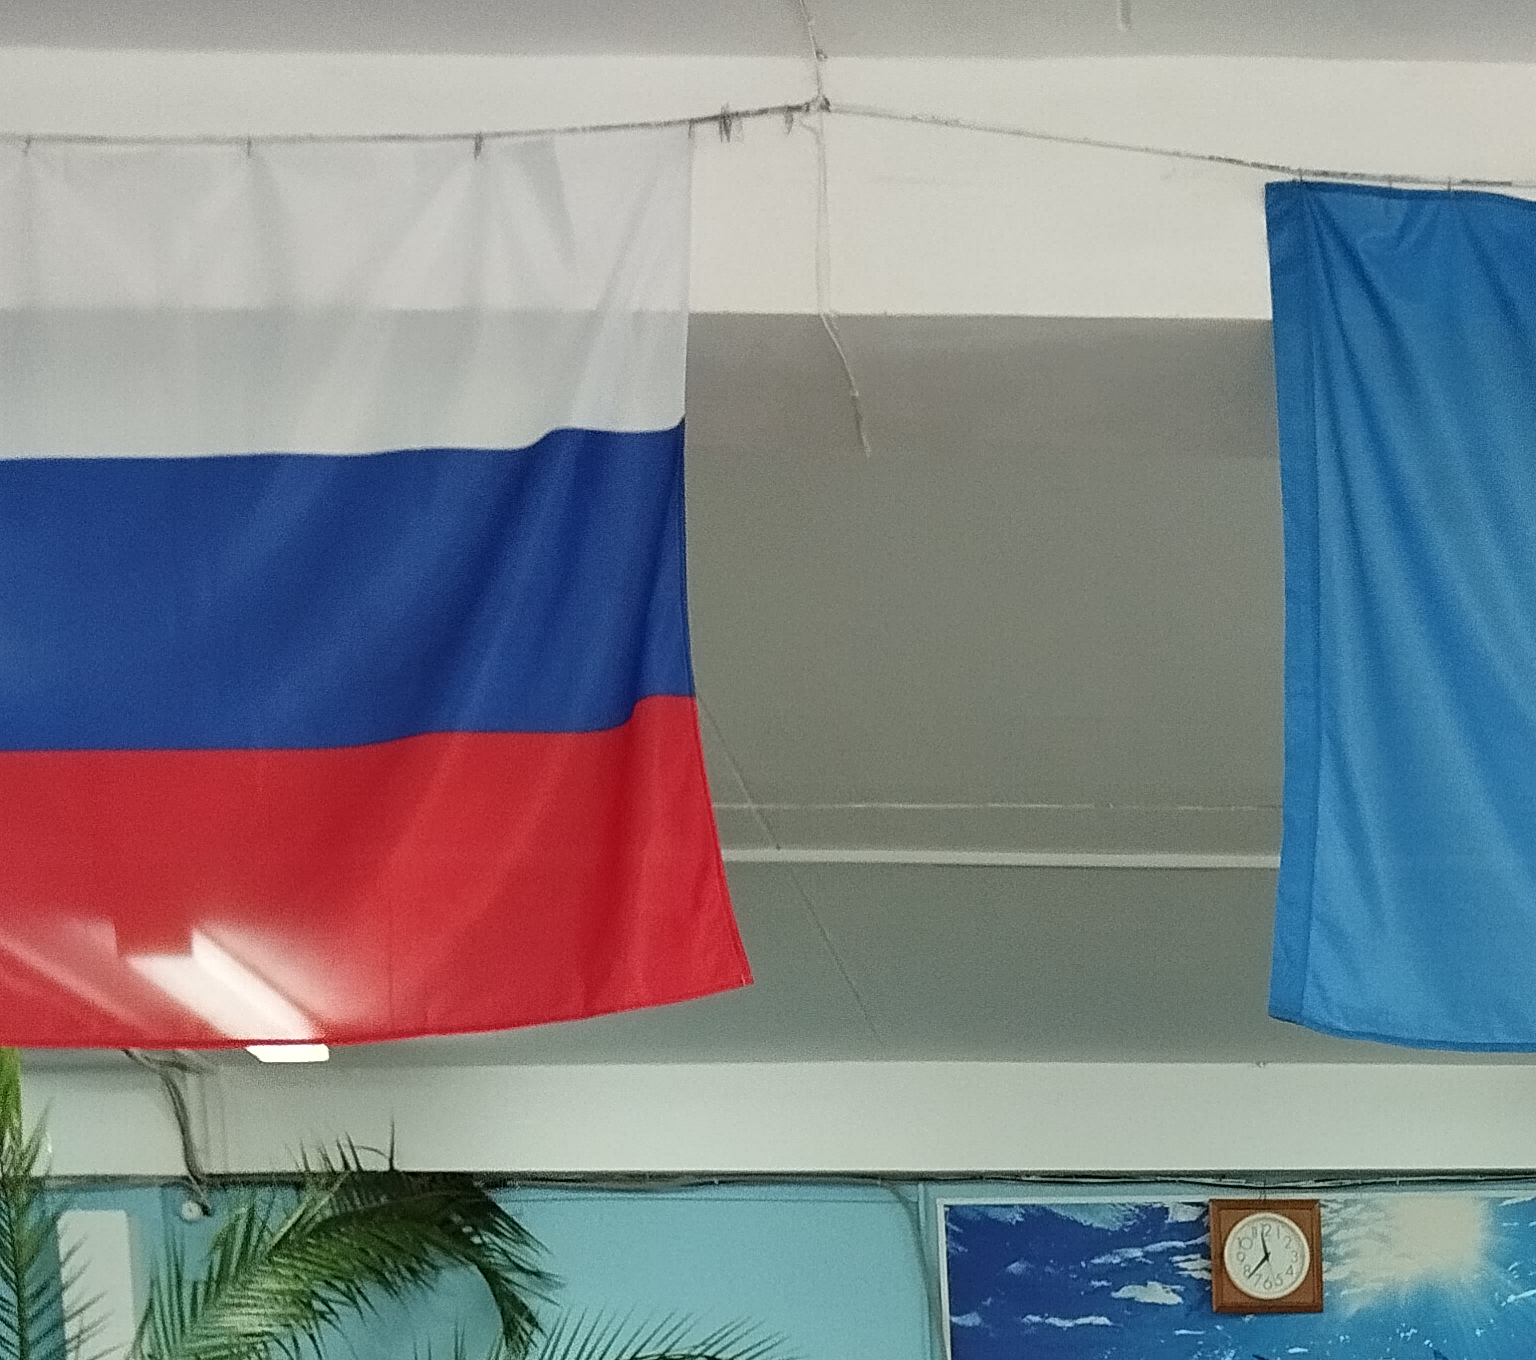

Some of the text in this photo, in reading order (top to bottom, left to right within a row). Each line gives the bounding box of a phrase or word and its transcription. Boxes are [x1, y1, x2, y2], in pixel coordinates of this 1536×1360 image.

[1251, 1226, 1258, 1240] 11
[1237, 1235, 1253, 1251] 10
[1283, 1235, 1292, 1250] 2
[1236, 1251, 1245, 1266] 9
[1290, 1250, 1298, 1264] 3
[1285, 1264, 1294, 1277] 4
[1253, 1272, 1263, 1287] 7
[1263, 1275, 1273, 1290] 6
